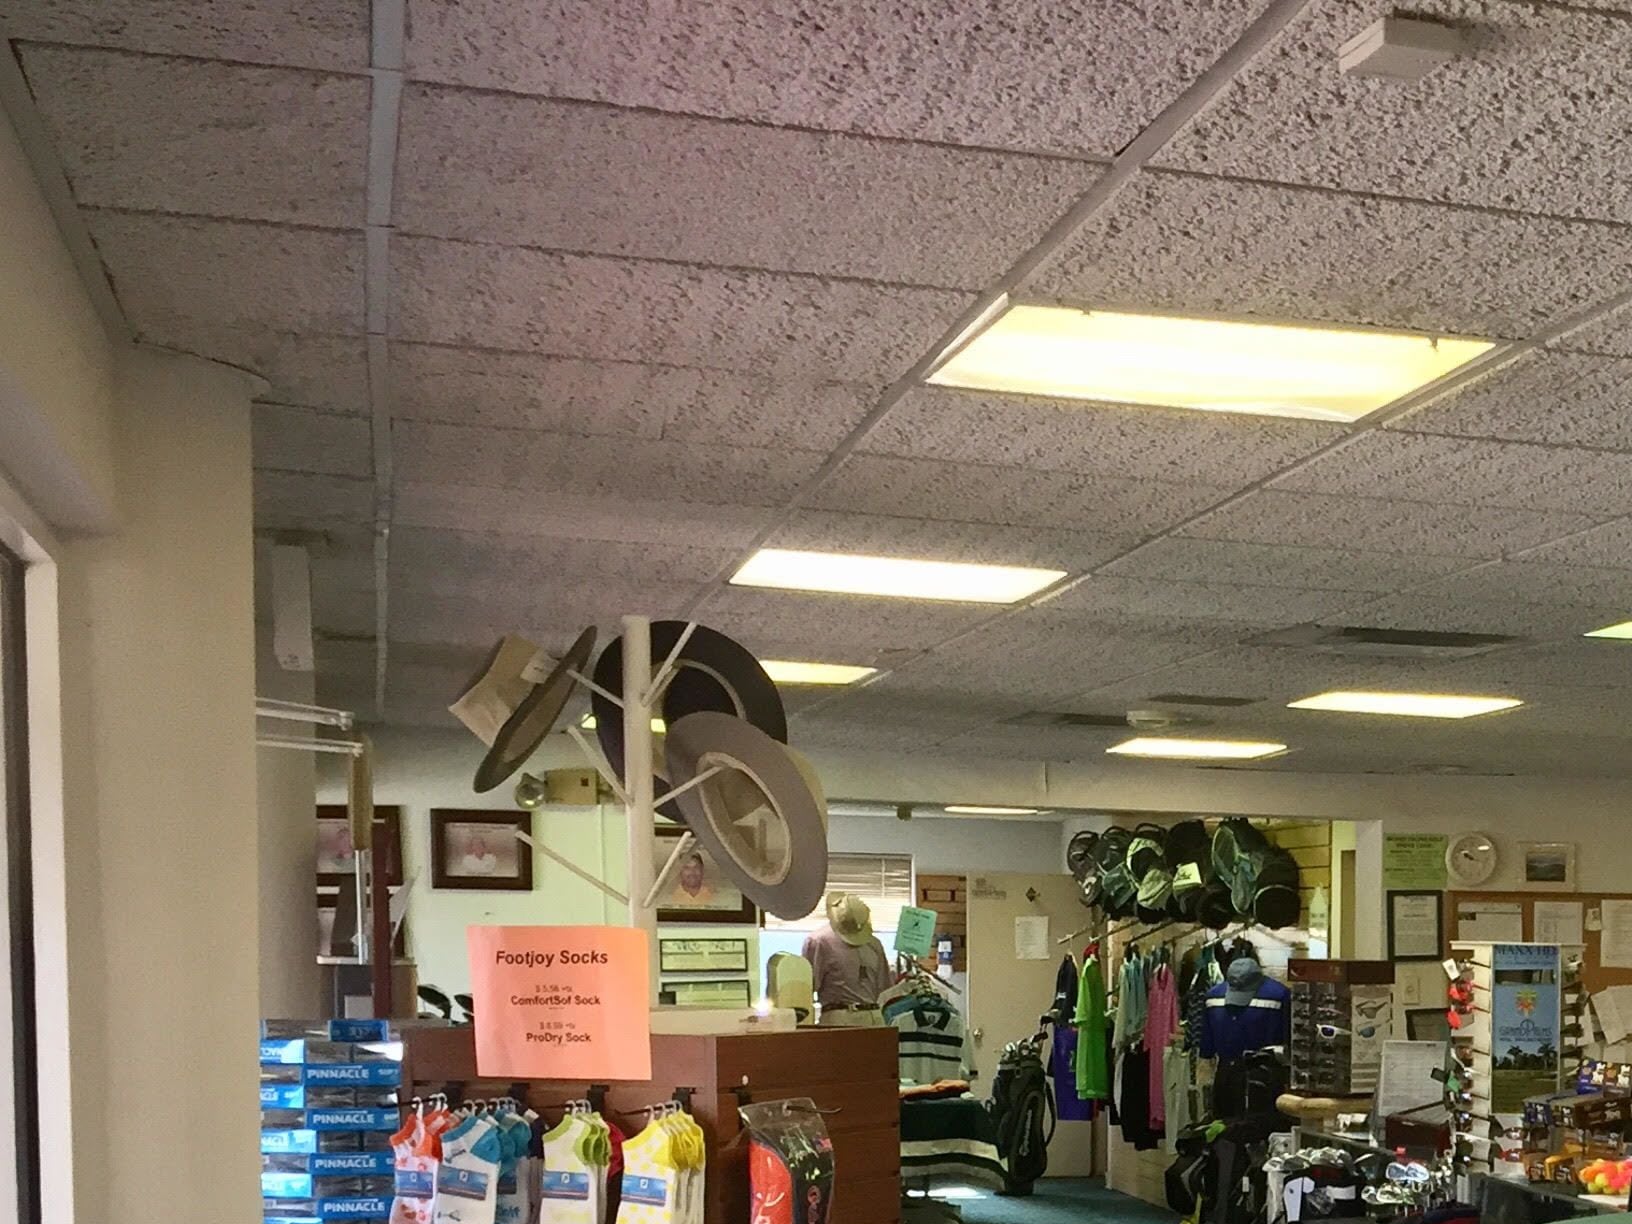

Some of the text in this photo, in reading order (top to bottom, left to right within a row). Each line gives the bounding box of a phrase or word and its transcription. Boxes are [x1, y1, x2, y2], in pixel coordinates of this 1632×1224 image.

[495, 950, 608, 967] Footjoy Socks
[574, 995, 601, 1005] Sock
[526, 1032, 591, 1044] ProDry Sock
[307, 1069, 370, 1079] PINNACLE
[313, 1113, 375, 1124] PINNACLE
[315, 1158, 377, 1168] PINNACLE
[324, 1202, 385, 1212] PINNACLE
